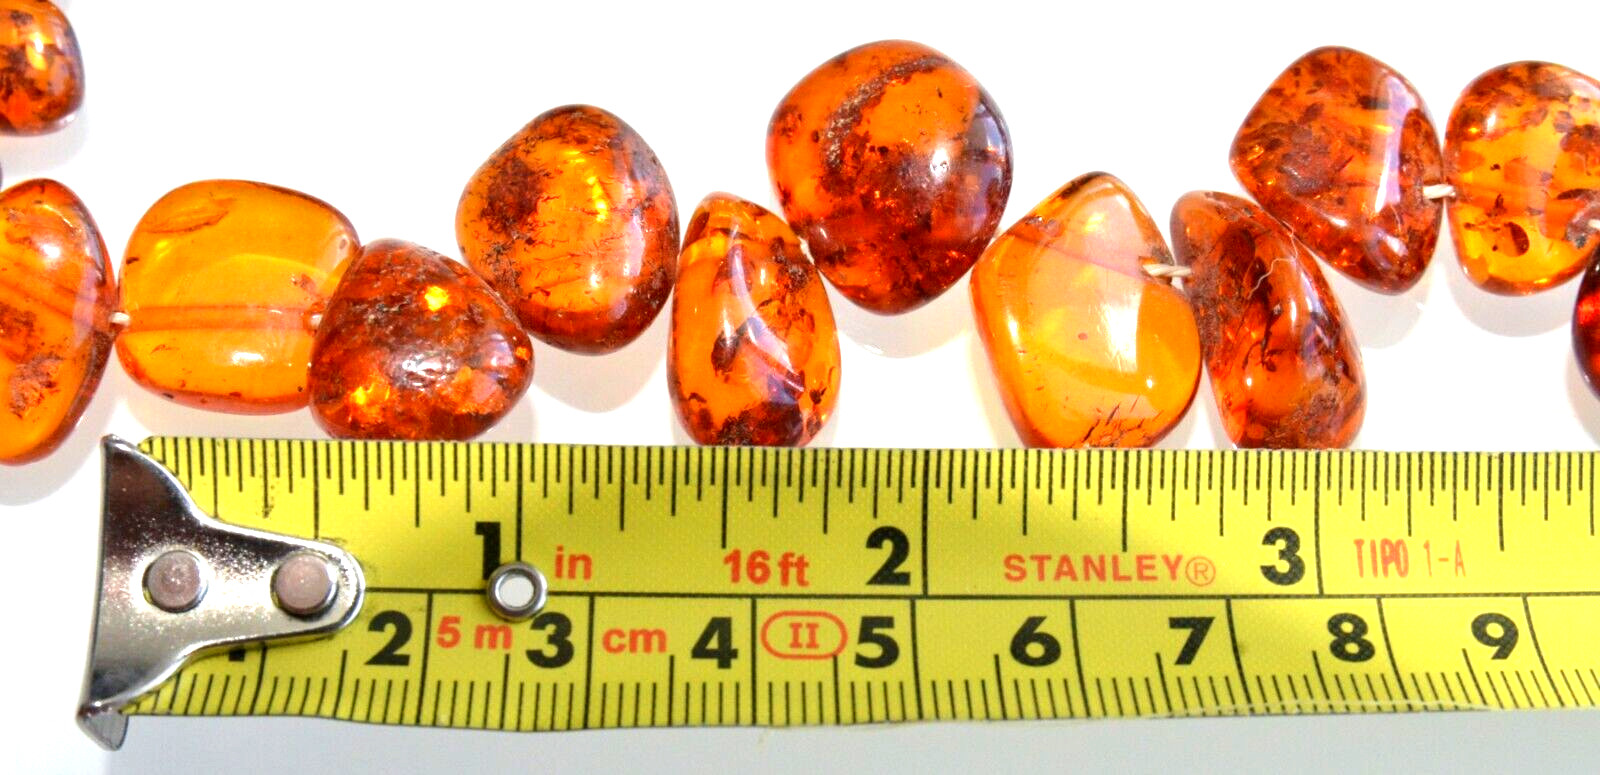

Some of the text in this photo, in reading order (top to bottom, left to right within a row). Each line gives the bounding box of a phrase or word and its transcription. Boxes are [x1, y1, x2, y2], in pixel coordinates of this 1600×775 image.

[474, 521, 501, 580] 1
[555, 545, 592, 580] in
[723, 549, 809, 587] 16 ft
[866, 526, 911, 586] 2
[1260, 526, 1306, 586] 3
[1353, 538, 1409, 578] TIPO
[364, 610, 412, 666] 2
[436, 616, 513, 650] 5 m
[525, 612, 575, 669] 3
[602, 627, 667, 654] cm
[691, 616, 738, 669] 4
[854, 616, 900, 669] 5
[1010, 616, 1061, 667] 6
[1168, 616, 1215, 665] 7
[1327, 612, 1376, 662] 8
[1471, 612, 1519, 660] 9
